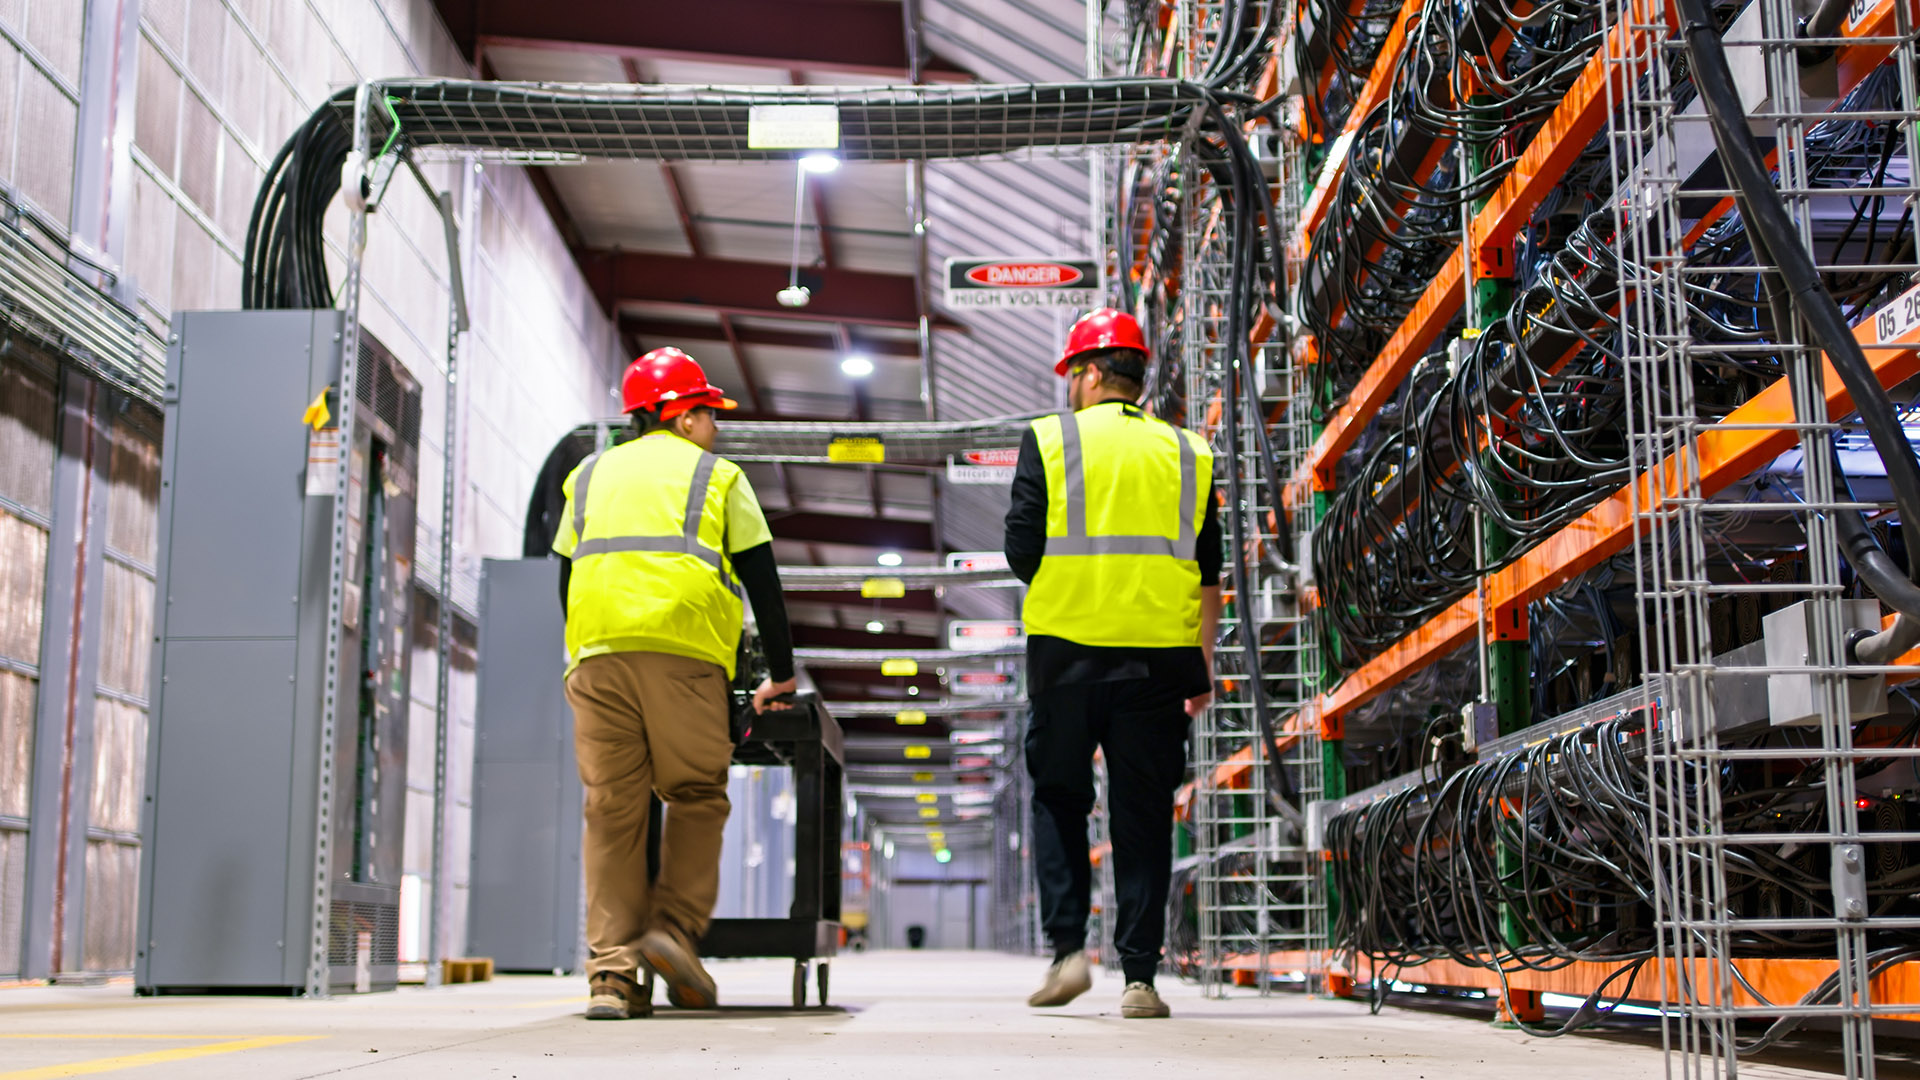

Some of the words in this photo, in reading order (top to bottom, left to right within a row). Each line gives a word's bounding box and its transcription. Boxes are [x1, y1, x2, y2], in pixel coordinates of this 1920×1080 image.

[987, 266, 1061, 283] DANGER
[954, 291, 1001, 305] HIGH
[1007, 291, 1092, 305] VOLTAGE
[980, 450, 1018, 463] DANG
